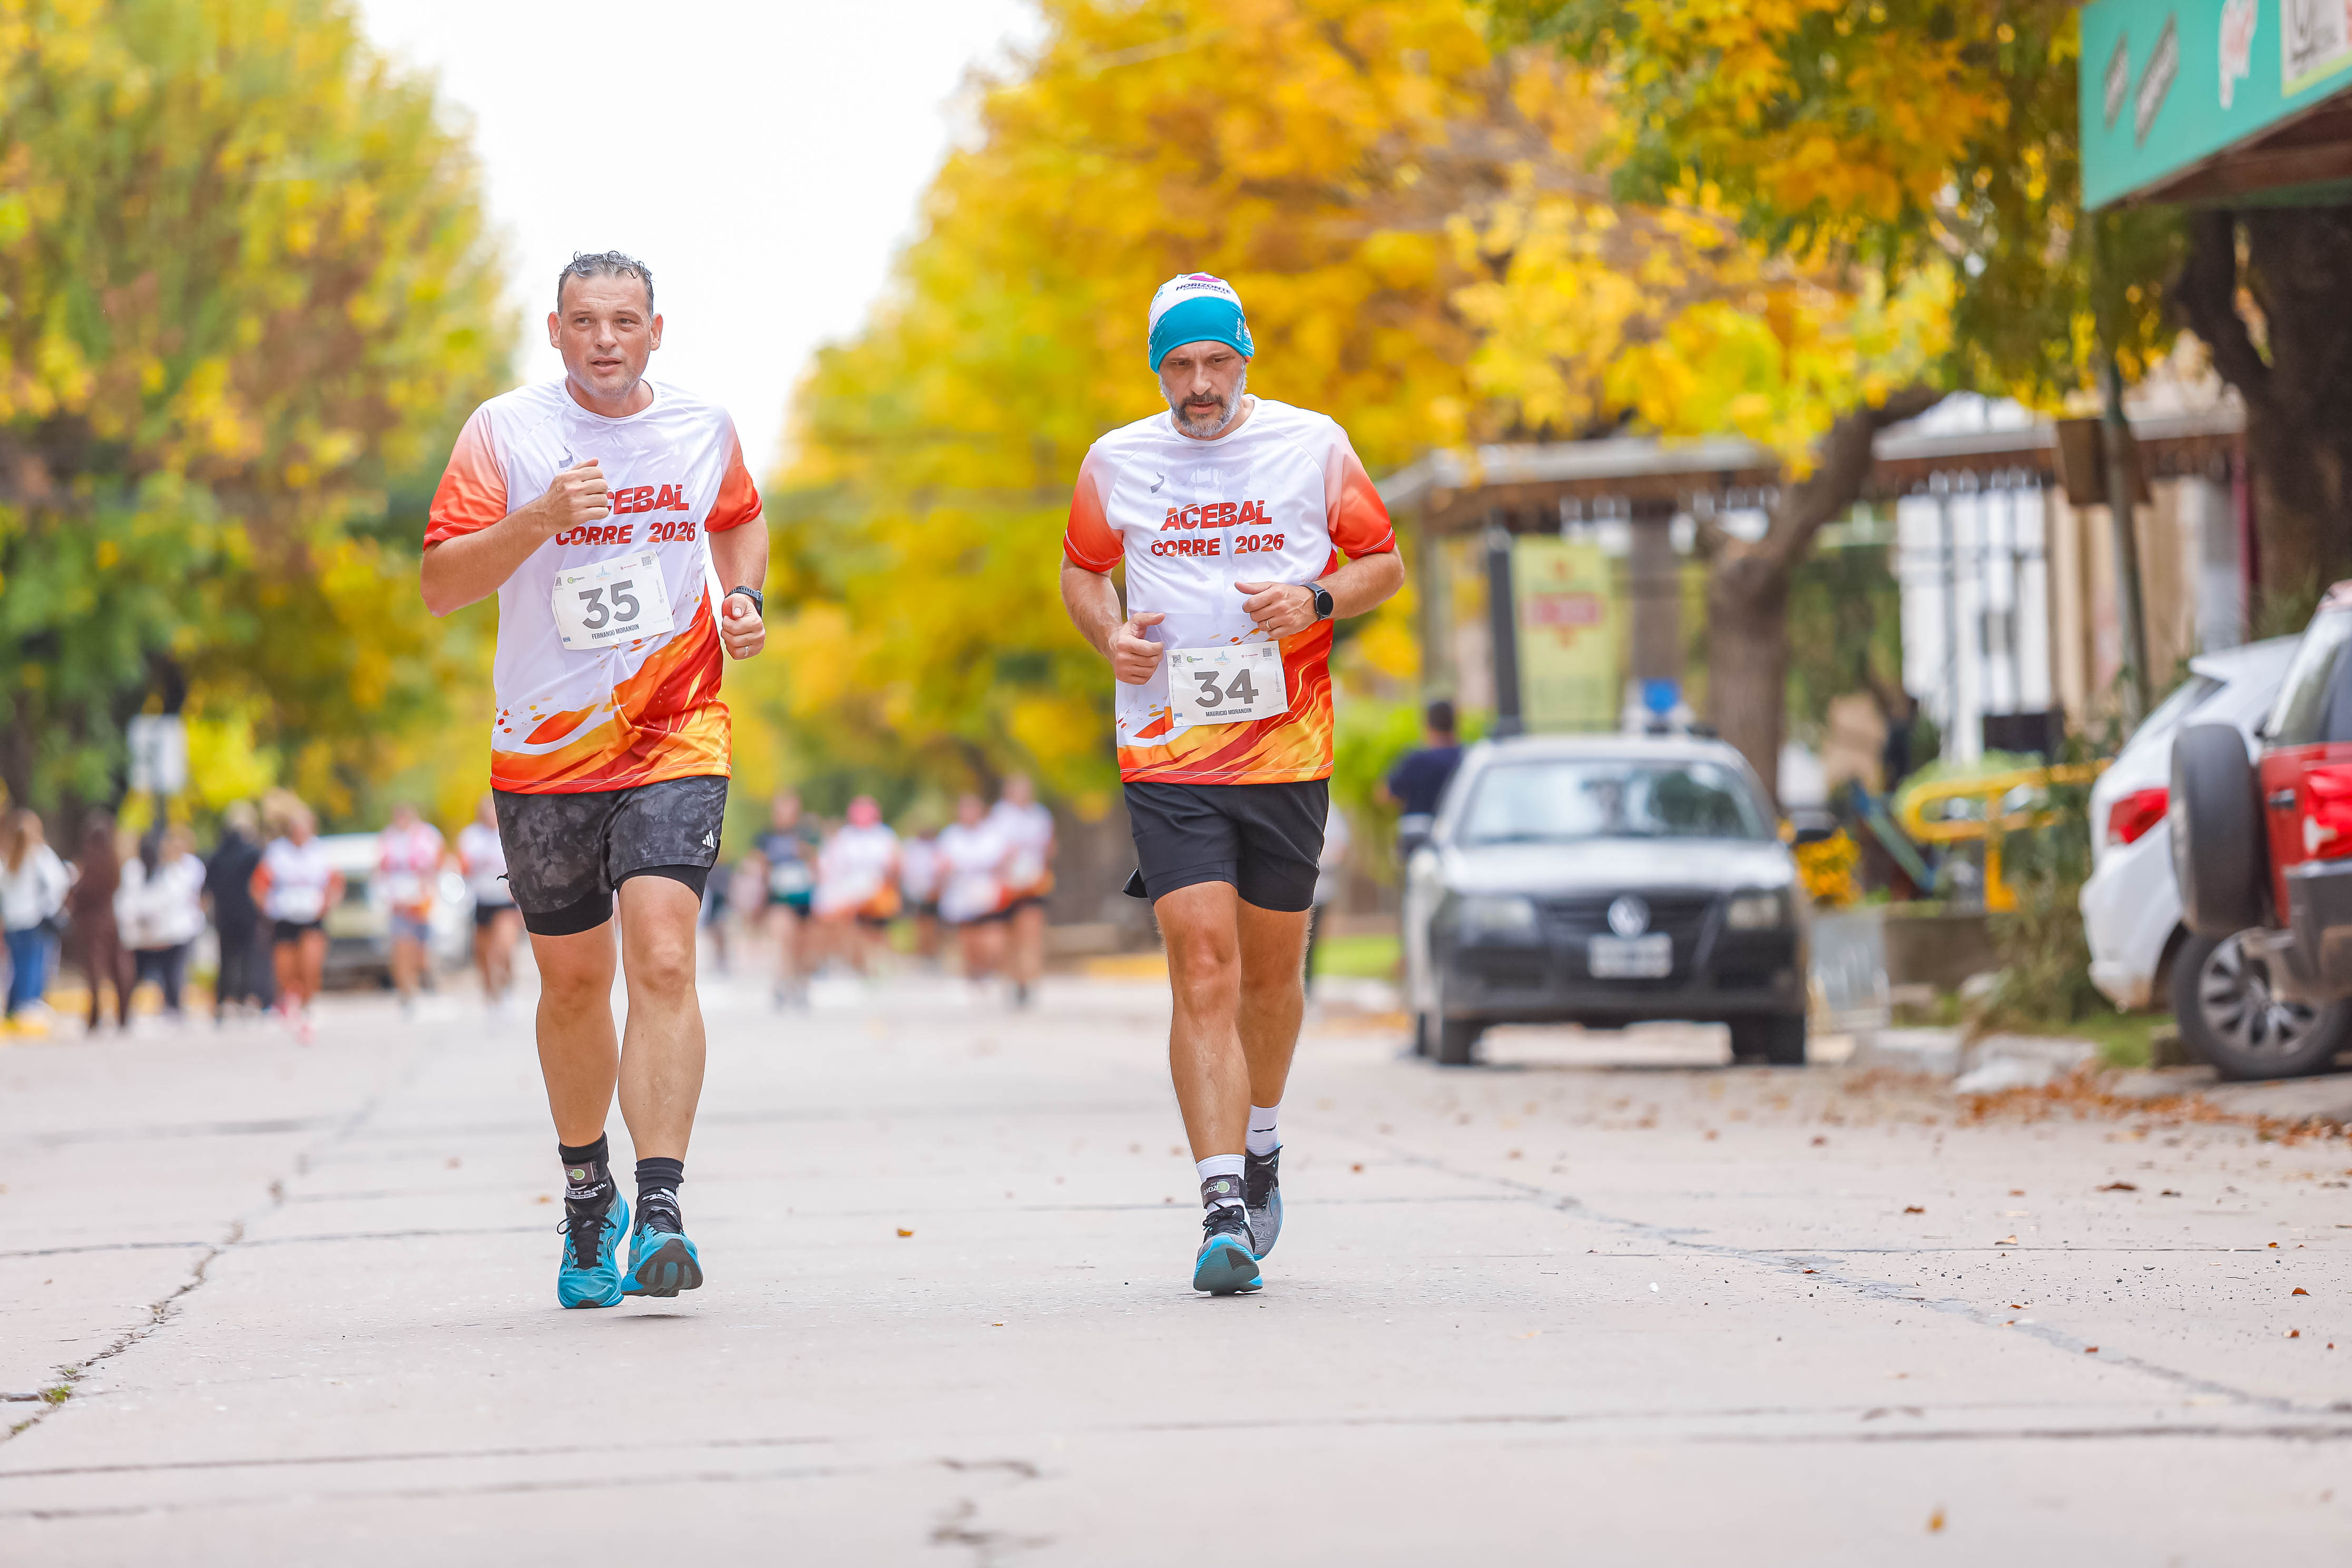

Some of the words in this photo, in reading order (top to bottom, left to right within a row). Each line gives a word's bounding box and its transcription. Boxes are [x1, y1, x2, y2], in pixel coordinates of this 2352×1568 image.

[1176, 283, 1231, 294] HORIZONTE
[1160, 500, 1272, 531] ACEBAL
[555, 524, 634, 545] CORRE
[647, 521, 696, 542] 2026
[1151, 537, 1220, 557] CORRE
[1234, 534, 1285, 554] 2026
[579, 580, 640, 629] 35
[592, 630, 615, 639] FERNANDO
[615, 624, 639, 634] MORANDIN
[1194, 669, 1259, 708] 34
